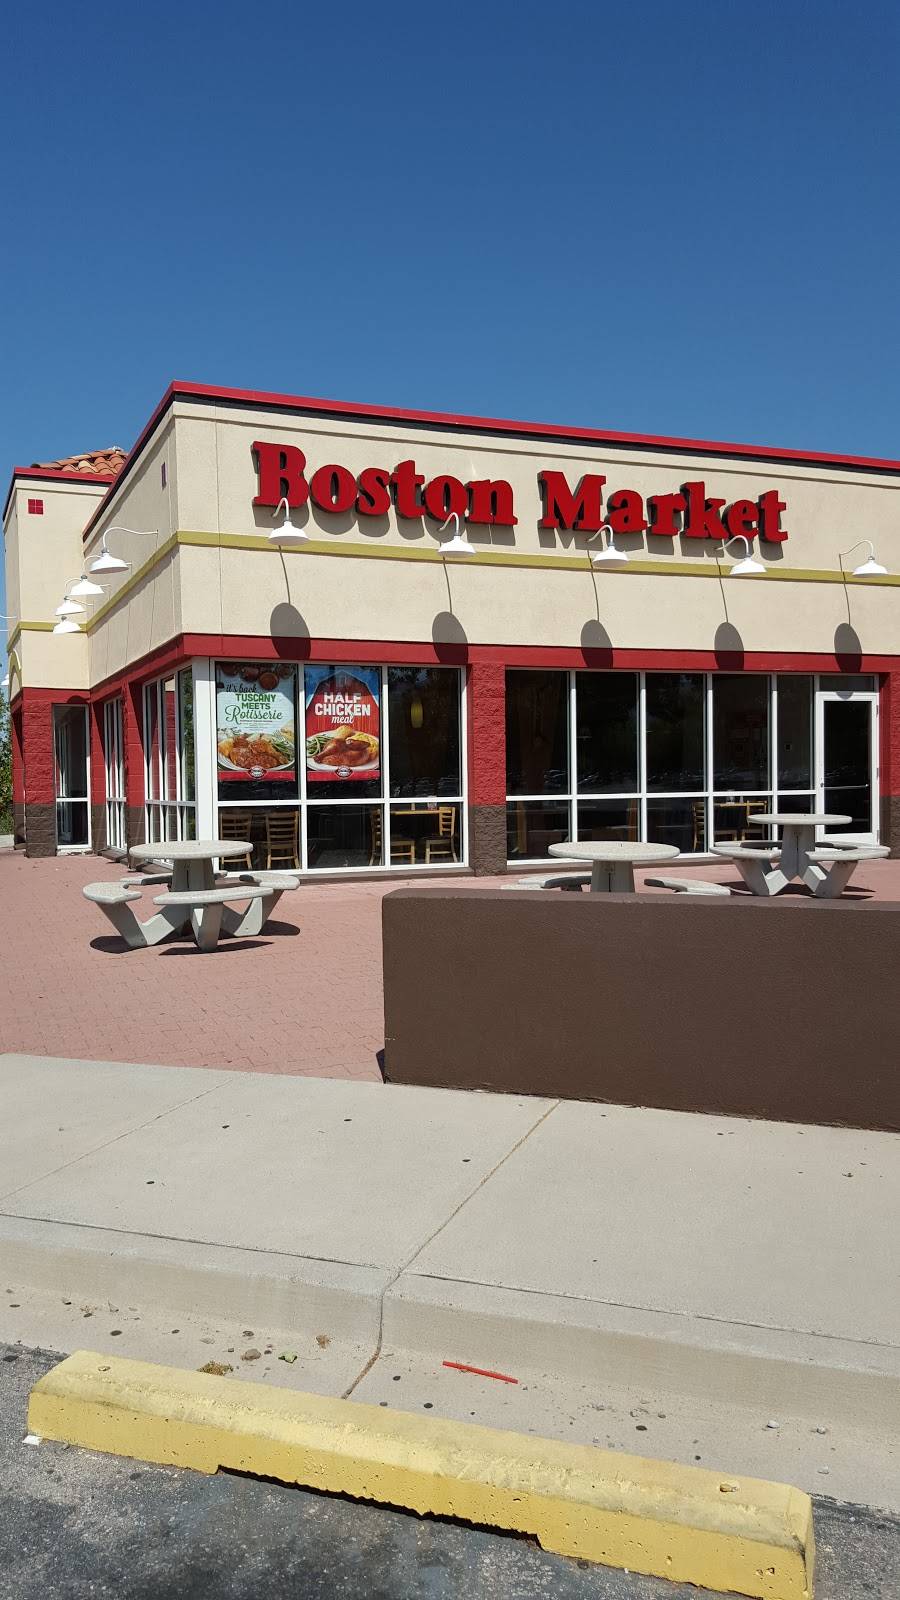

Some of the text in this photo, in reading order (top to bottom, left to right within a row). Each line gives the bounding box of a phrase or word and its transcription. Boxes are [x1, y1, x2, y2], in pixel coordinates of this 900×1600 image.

[251, 441, 788, 543] Boston Market
[226, 683, 257, 693] it's back
[236, 694, 276, 703] TUSCANY
[324, 692, 362, 703] HALF
[225, 705, 283, 724] Rotisserie
[315, 703, 371, 716] CHICKEN
[331, 712, 354, 724] meal
